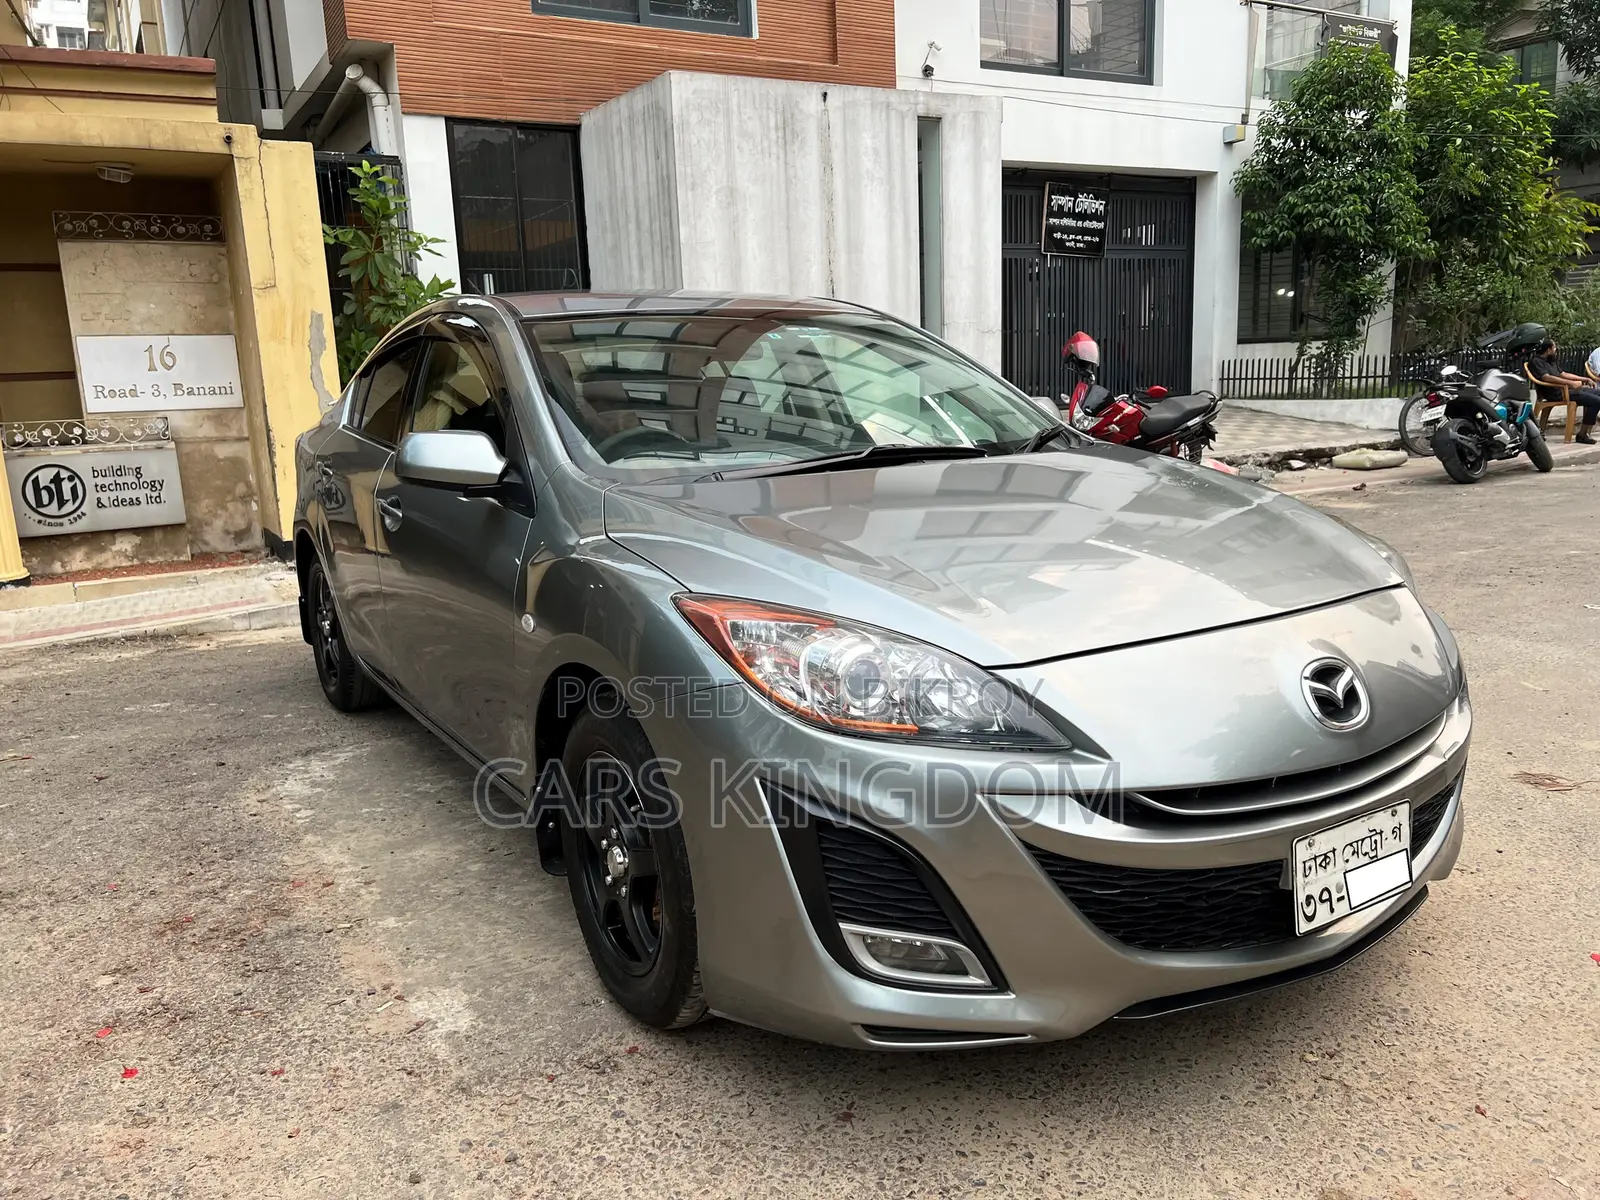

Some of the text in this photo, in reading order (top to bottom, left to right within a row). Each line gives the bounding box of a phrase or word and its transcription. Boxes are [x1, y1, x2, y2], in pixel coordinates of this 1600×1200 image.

[1075, 192, 1106, 216] টেলিভিশন
[144, 337, 177, 371] 16
[92, 381, 235, 400] Road- 3, Banani
[91, 465, 143, 480] building
[31, 469, 80, 512] bti
[94, 478, 165, 493] technology
[145, 493, 167, 505] ltd.
[1302, 847, 1337, 878] ঢাকা
